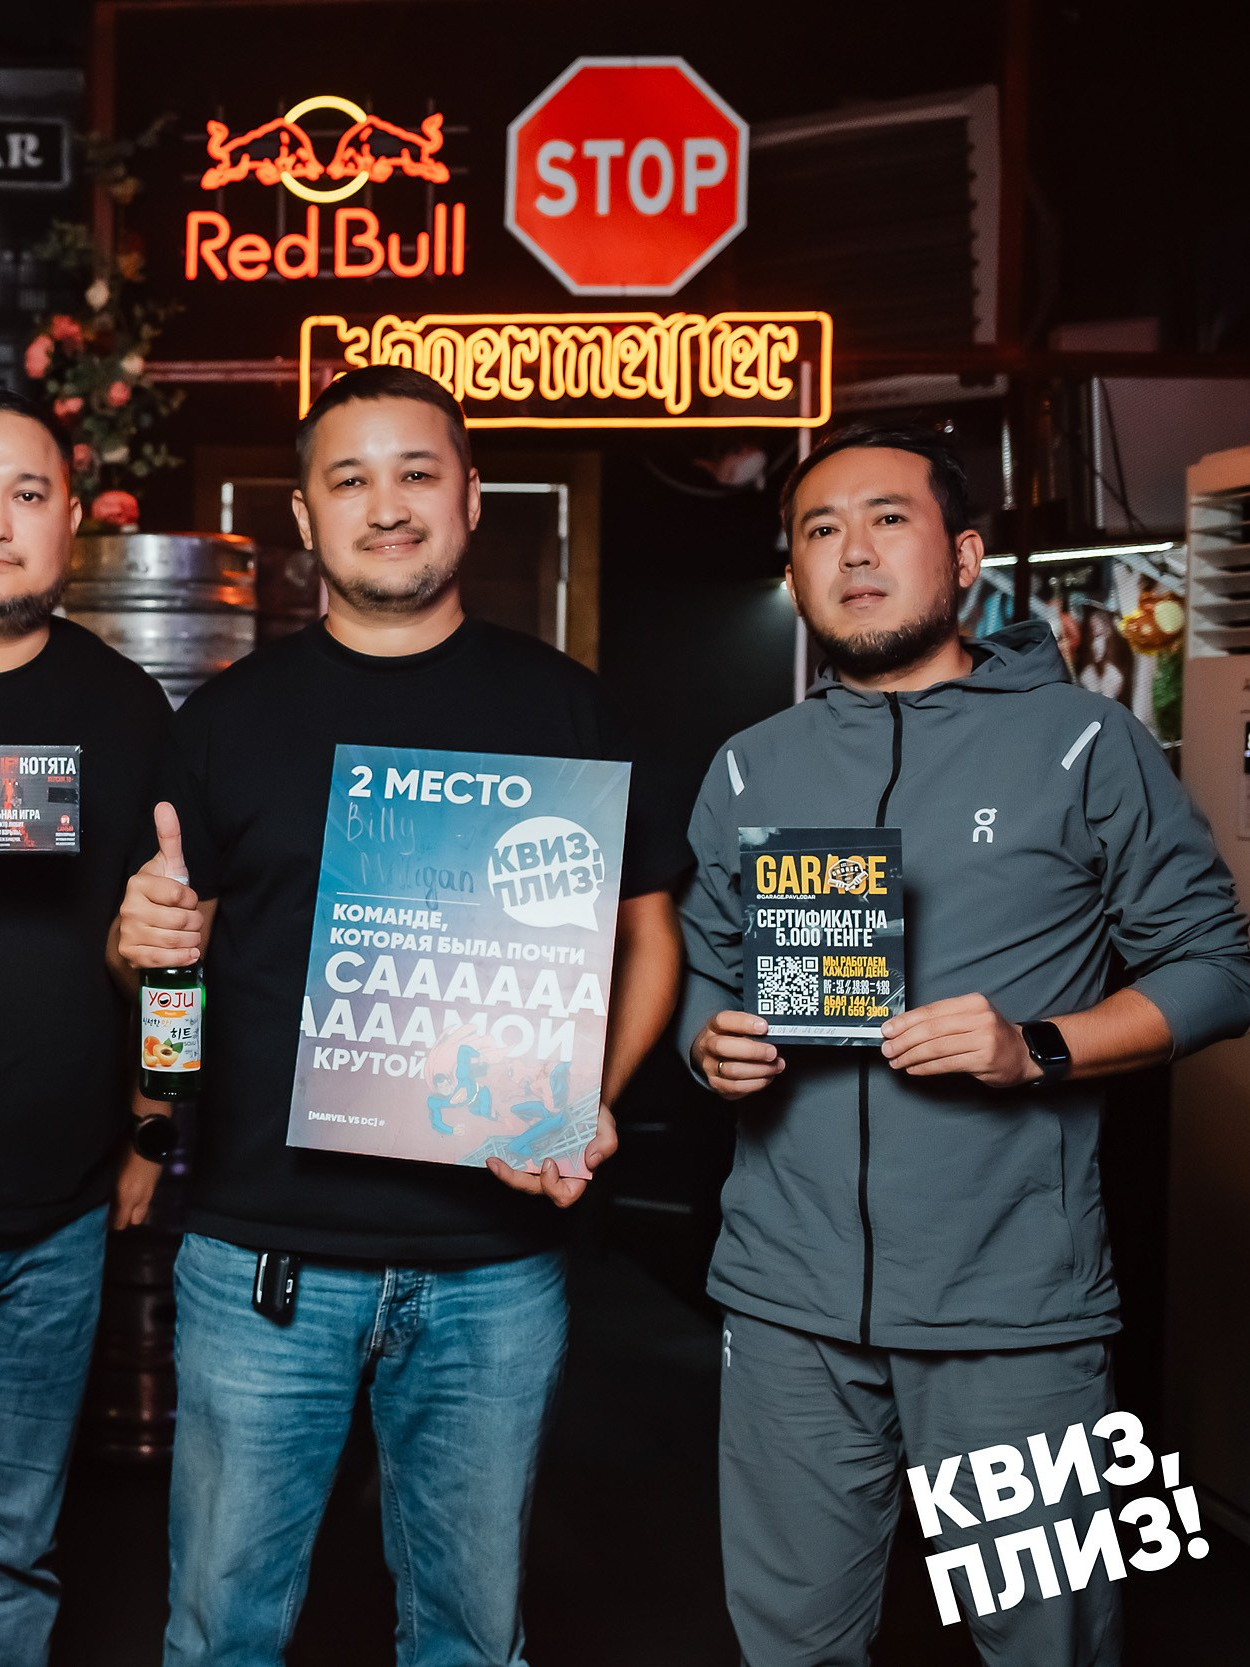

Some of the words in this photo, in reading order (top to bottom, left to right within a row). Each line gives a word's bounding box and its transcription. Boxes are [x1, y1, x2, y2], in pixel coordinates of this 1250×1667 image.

[535, 138, 729, 217] STOP
[185, 205, 321, 281] Red
[334, 203, 466, 278] Bull
[19, 756, 76, 775] КОТЯТА
[348, 765, 373, 798] 2
[384, 767, 532, 809] МЕСТО
[19, 809, 41, 820] ИГРА
[347, 801, 416, 856] Billy
[492, 862, 603, 908] ПЛИЗ!
[333, 903, 448, 932] КОМАНДЕ,
[757, 909, 862, 928] СЕРТИФИКАТ
[865, 910, 888, 929] НА
[330, 927, 433, 953] КОТОРАЯ
[437, 936, 502, 959] БЫЛА
[507, 942, 585, 966] ПОЧТИ
[775, 927, 821, 947] 5.000
[824, 928, 873, 947] ТЕНГЕ
[823, 956, 839, 967] МЫ
[840, 956, 886, 967] РАБОТАЕМ
[823, 966, 864, 977] КАЖДЫЙ
[865, 967, 889, 978] ДЕНЬ
[148, 990, 194, 1009] YOJU
[824, 995, 847, 1006] АБАЯ
[170, 1027, 192, 1040] 히트
[313, 1047, 427, 1079] КРУТОЙ
[308, 1110, 347, 1122] [MARVEL
[348, 1115, 360, 1124] VS
